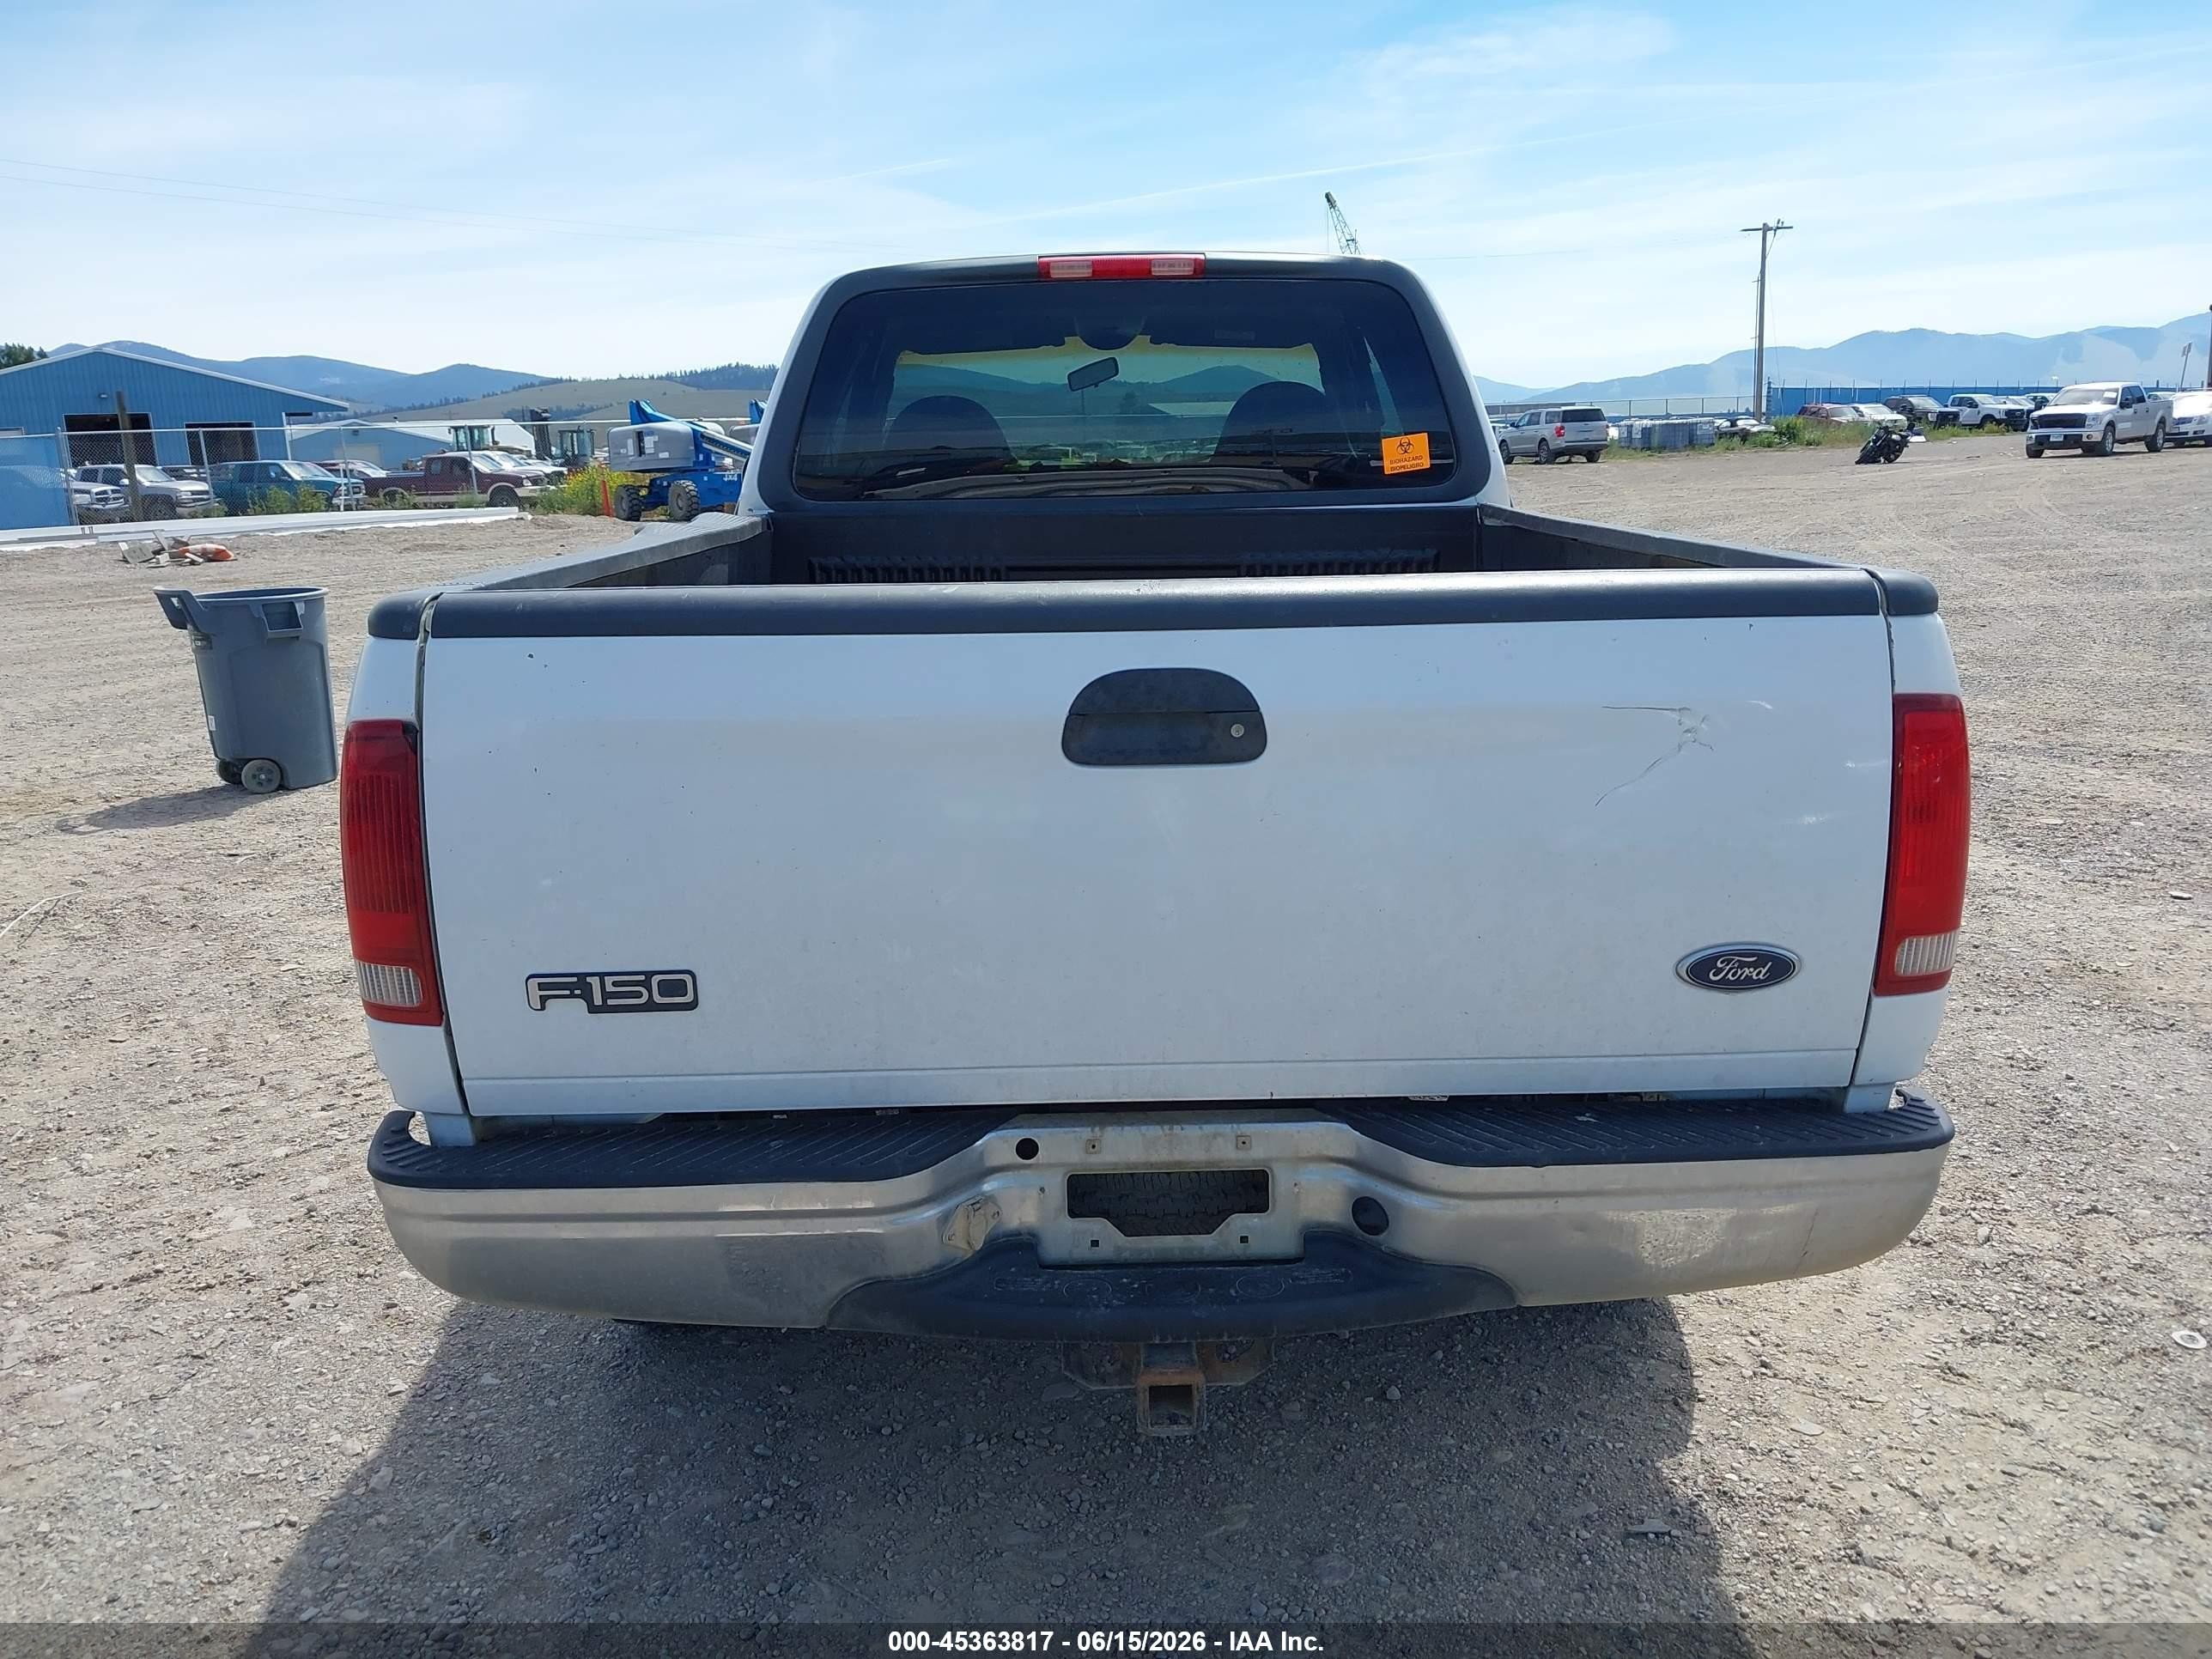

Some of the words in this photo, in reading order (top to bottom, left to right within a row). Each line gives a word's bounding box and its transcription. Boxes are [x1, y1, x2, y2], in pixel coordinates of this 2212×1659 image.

[1389, 455, 1424, 465] BIOHAZARD
[1390, 462, 1425, 471] BIOPELIGRO
[1709, 956, 1772, 981] Ford
[526, 974, 695, 1010] F-150
